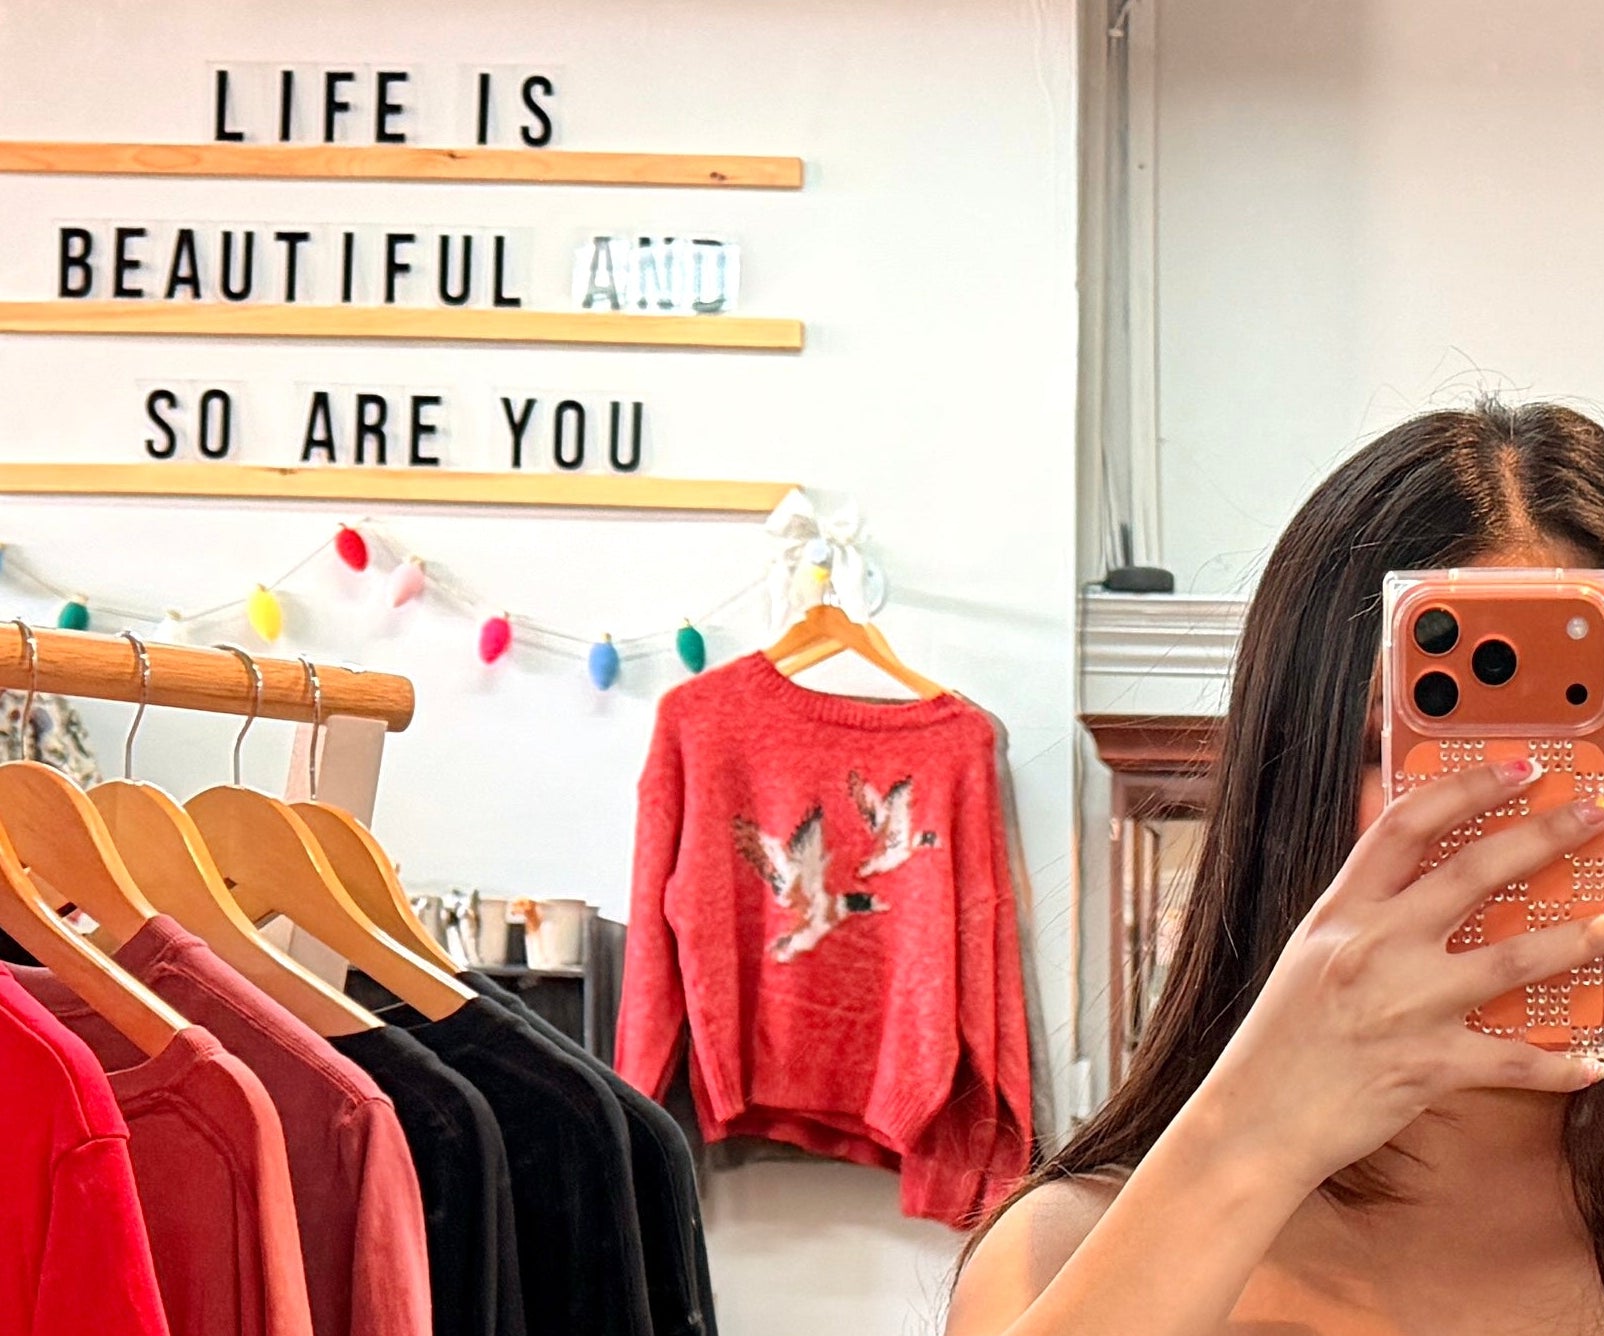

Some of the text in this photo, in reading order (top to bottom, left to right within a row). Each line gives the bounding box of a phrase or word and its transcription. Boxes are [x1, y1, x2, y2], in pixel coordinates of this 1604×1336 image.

[214, 69, 556, 148] LIFE IS
[58, 226, 727, 314] BEAUTIFUL AND
[144, 387, 646, 474] SO ARE YOU
